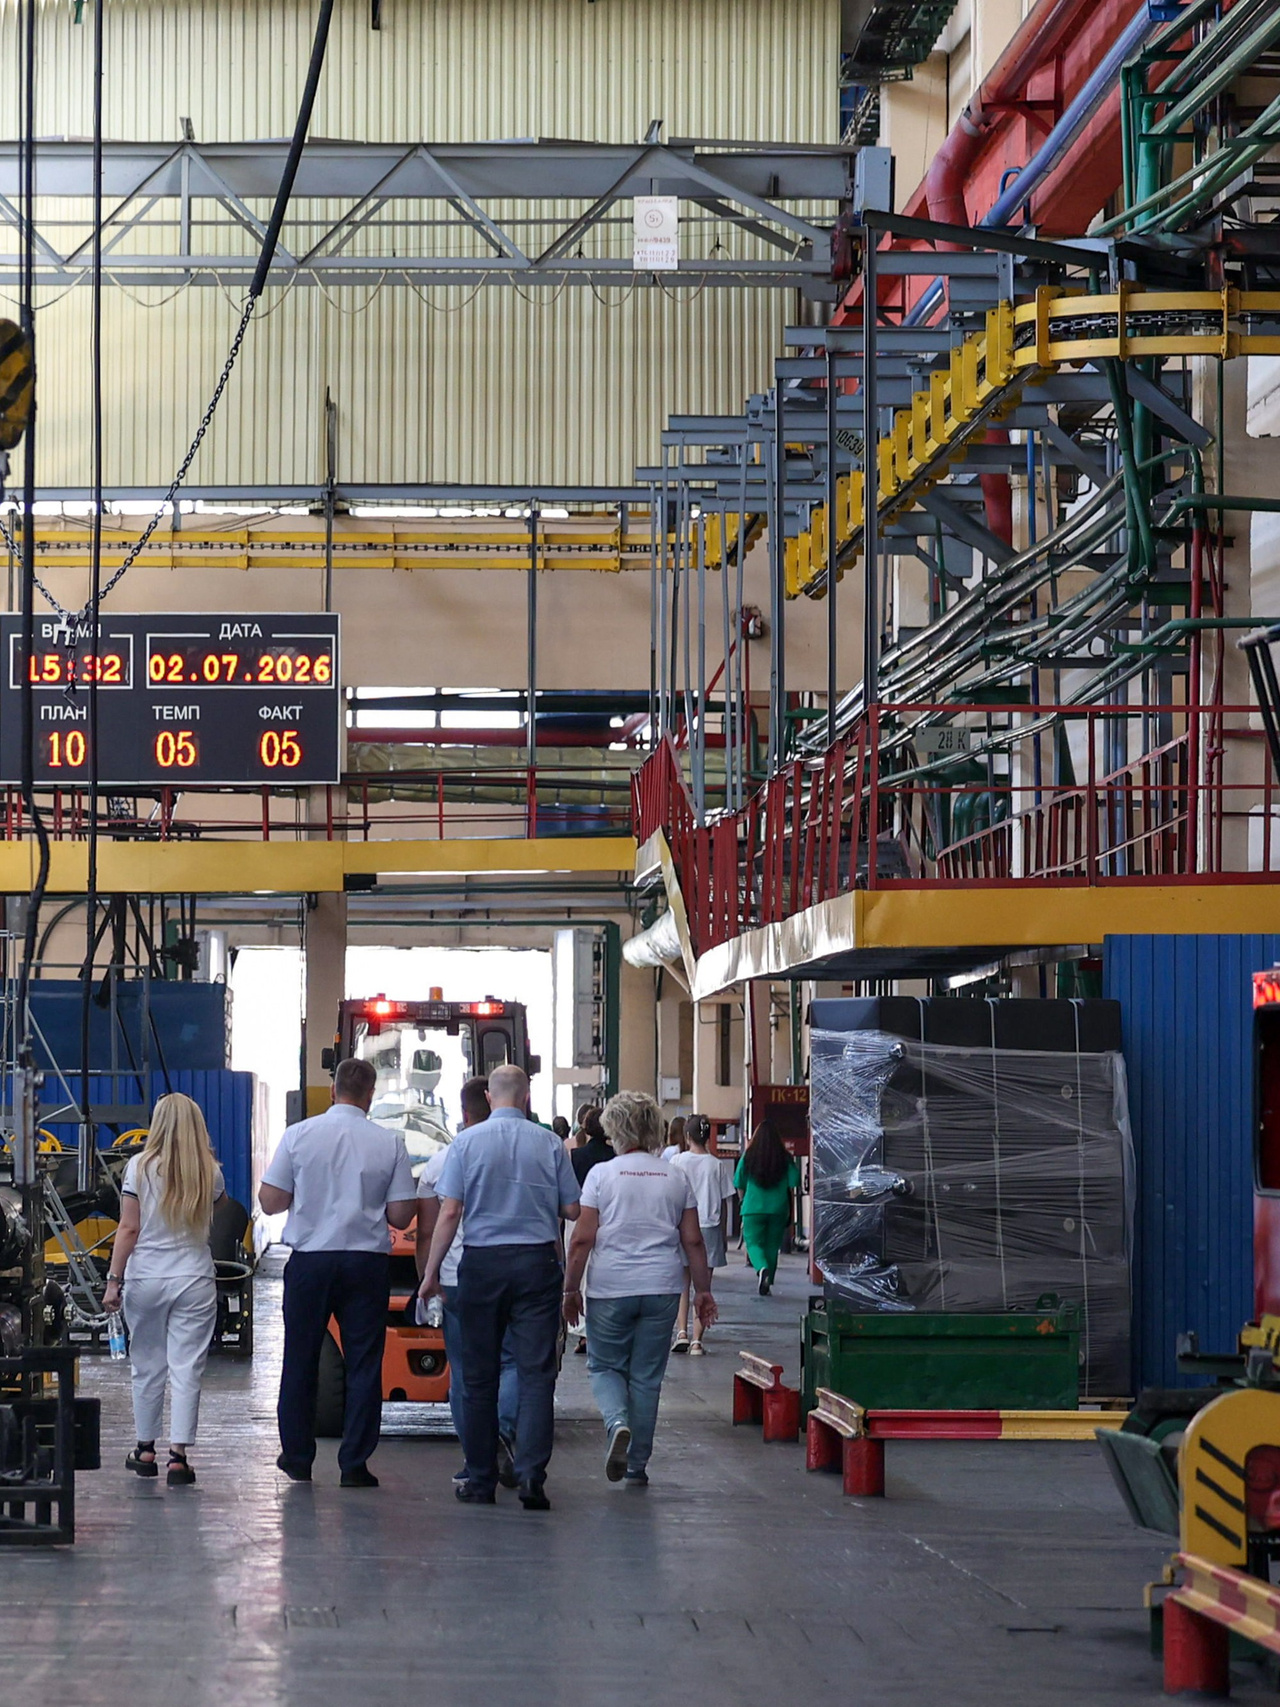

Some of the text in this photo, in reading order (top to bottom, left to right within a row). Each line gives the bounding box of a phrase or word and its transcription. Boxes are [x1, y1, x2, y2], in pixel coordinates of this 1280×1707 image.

[218, 623, 263, 639] ДАТА
[148, 654, 331, 682] 02.07.2026
[40, 706, 87, 721] ПЛАН
[152, 706, 200, 720] ТЕМП
[258, 705, 303, 721] ФАКТ
[48, 730, 86, 767] 10
[156, 730, 196, 767] 05
[260, 730, 301, 767] 05
